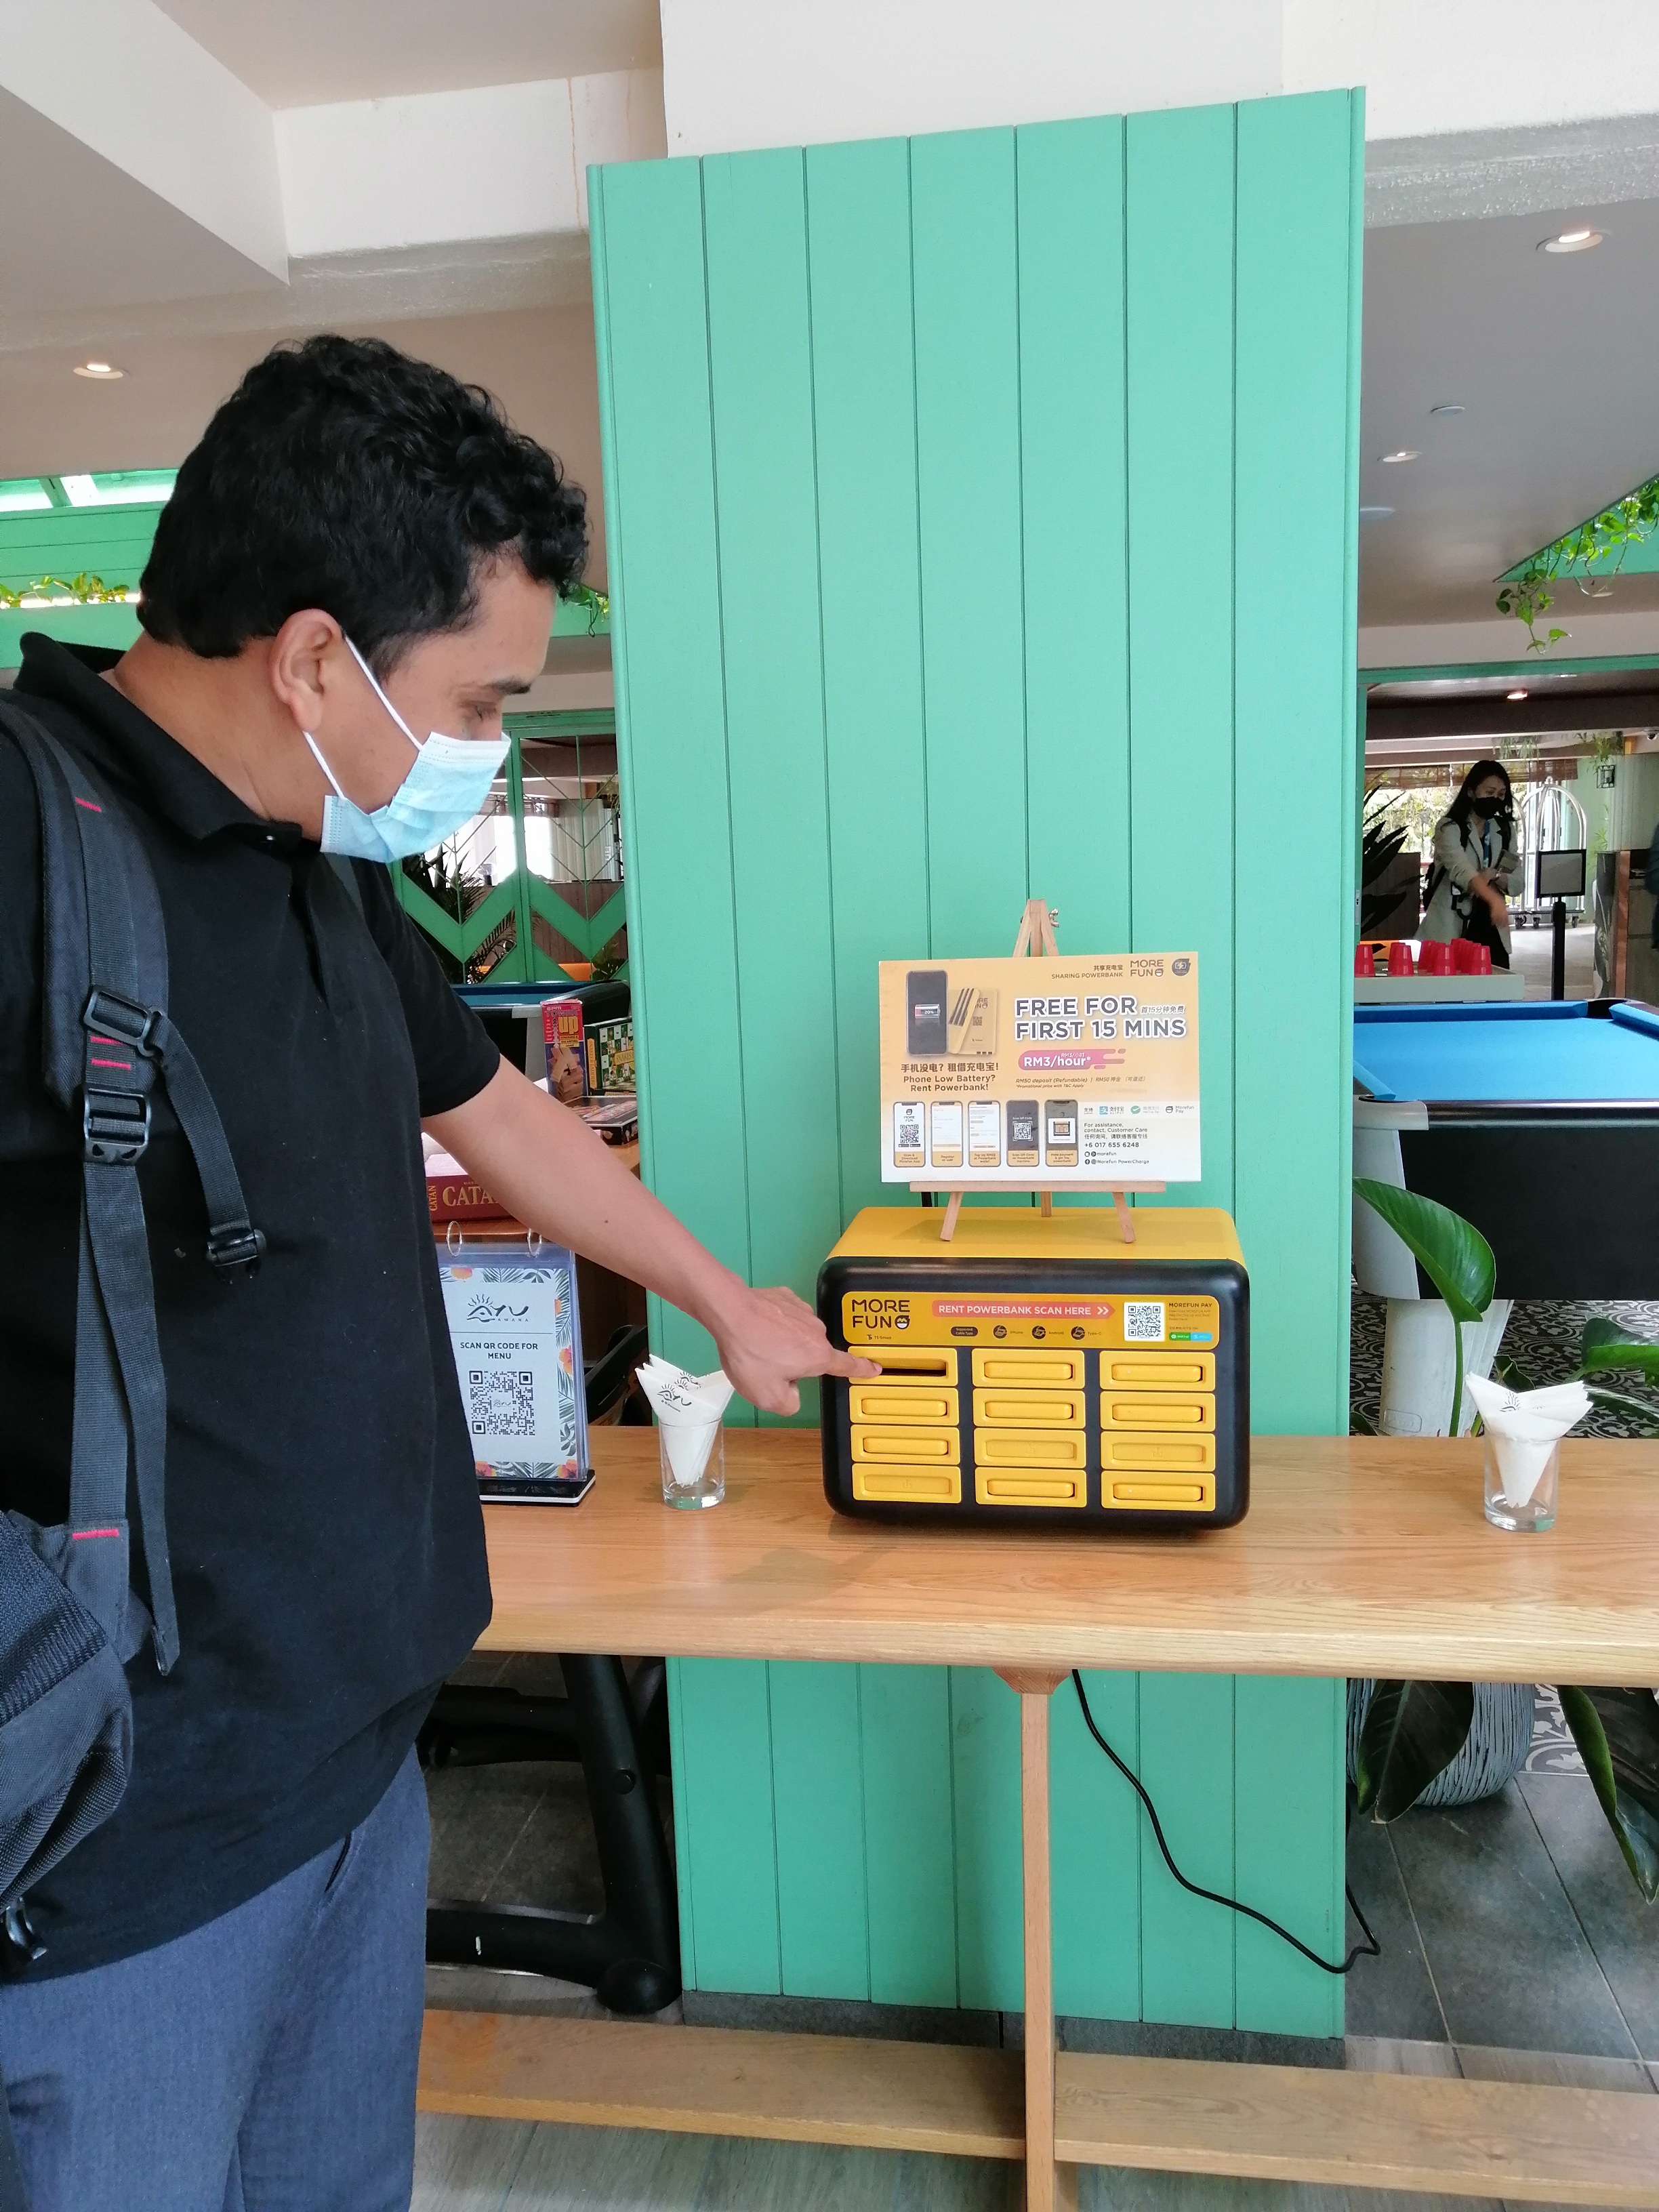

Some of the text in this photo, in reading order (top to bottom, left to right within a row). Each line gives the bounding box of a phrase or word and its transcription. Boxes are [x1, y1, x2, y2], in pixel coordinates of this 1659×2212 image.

[1130, 959, 1164, 968] MORE
[1130, 968, 1153, 977] FUN
[1016, 997, 1136, 1016] FREE FOR
[1016, 1019, 1185, 1039] FIRST 15 MINS
[956, 1074, 996, 1084] Battery?
[935, 1084, 989, 1092] Powerbank!
[428, 1185, 438, 1211] CATAN
[443, 1186, 499, 1206] CATA
[851, 1298, 910, 1313] MORE
[939, 1305, 1091, 1315] RENT POWERBANK SCAN HERE
[853, 1315, 892, 1328] FUN
[484, 1342, 495, 1350] QR
